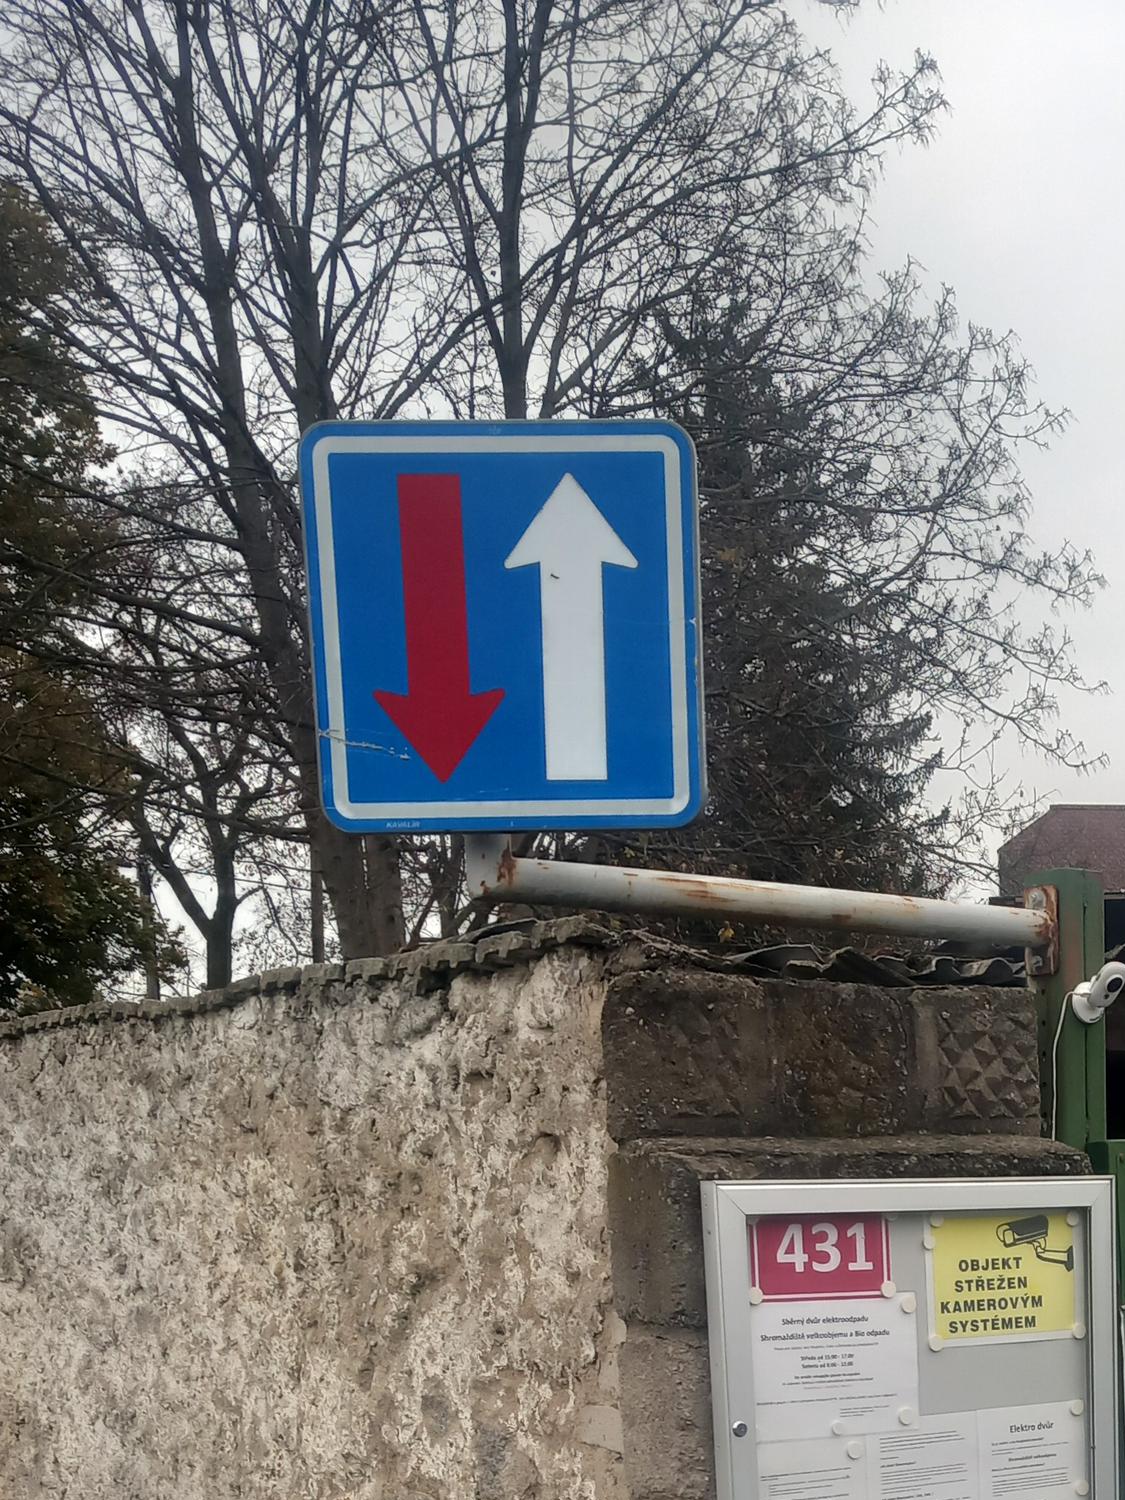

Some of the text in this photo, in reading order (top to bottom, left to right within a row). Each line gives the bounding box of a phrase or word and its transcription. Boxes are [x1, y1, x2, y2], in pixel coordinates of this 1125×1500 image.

[777, 1222, 873, 1272] 431
[958, 1257, 1022, 1272] OBJEKT
[955, 1274, 1028, 1293] STŘEŽEN
[940, 1293, 1043, 1314] KAMEROVÝM
[782, 1315, 869, 1326] Sběrný dvůr elektroodpadu
[949, 1315, 1036, 1333] SYSTÉMEM
[807, 1330, 848, 1340] velkoobjemu
[866, 1329, 890, 1337] odpadu
[1009, 1421, 1054, 1433] Elektro dvůr
